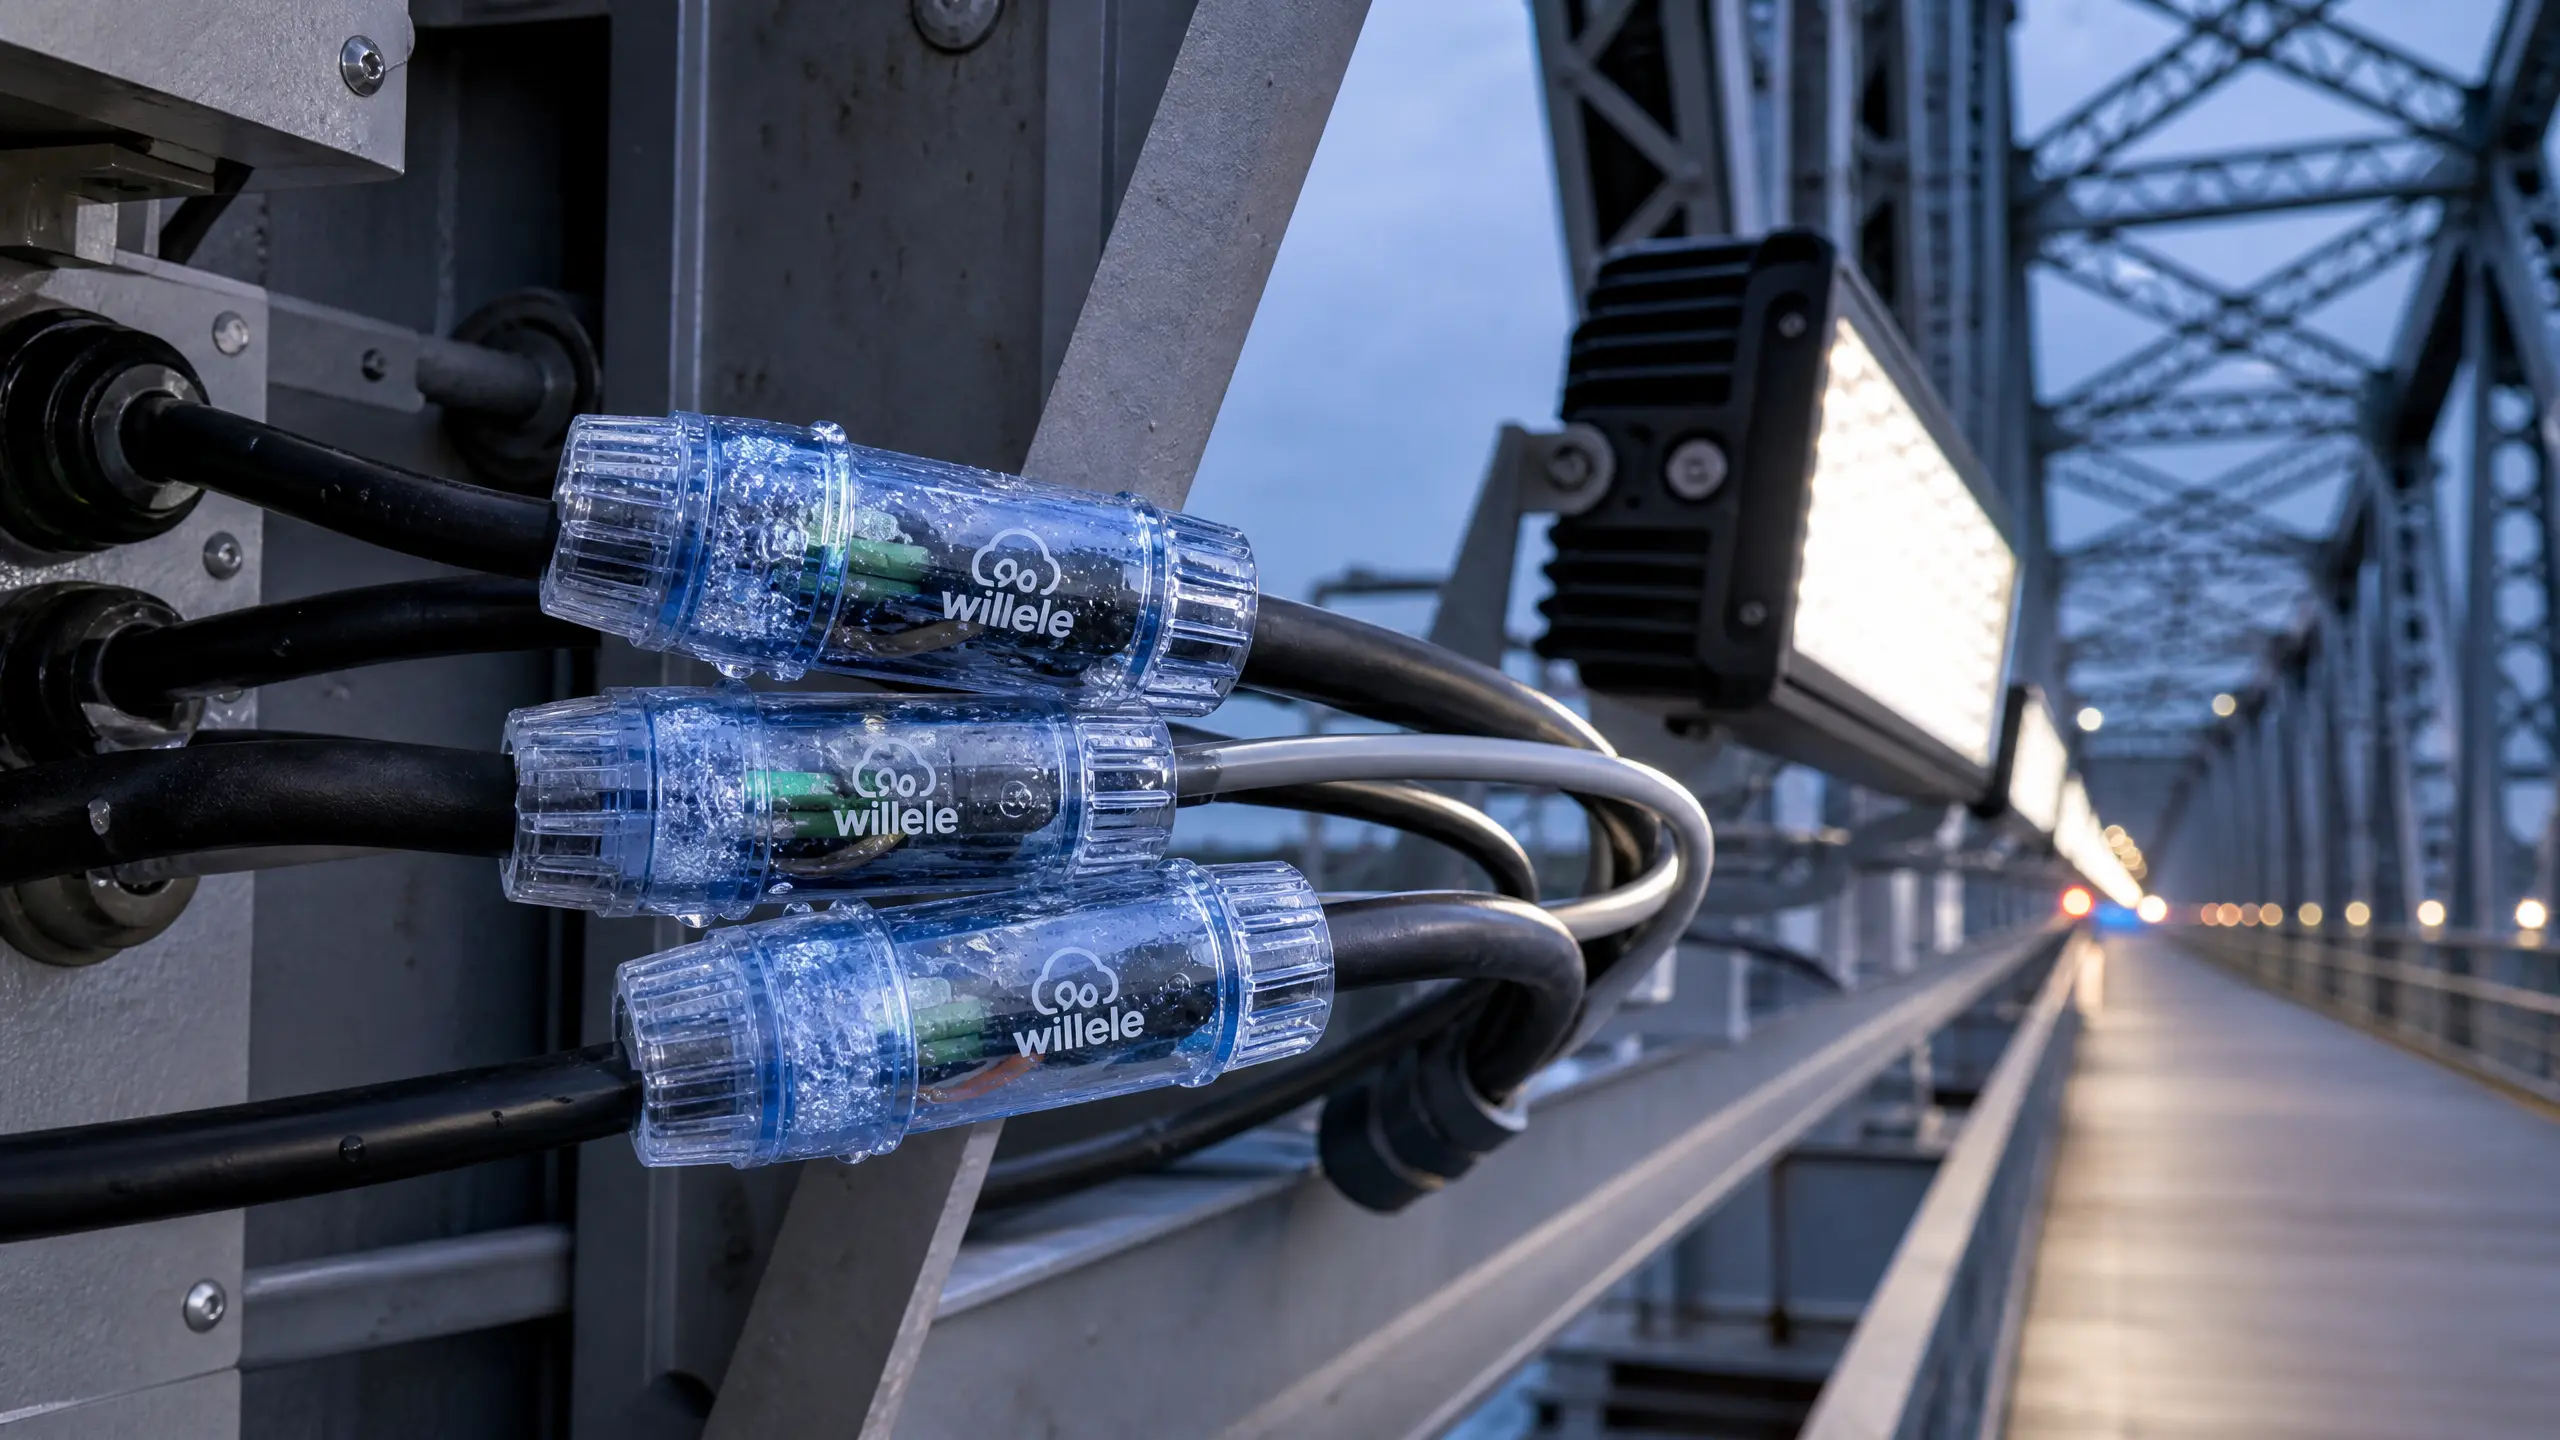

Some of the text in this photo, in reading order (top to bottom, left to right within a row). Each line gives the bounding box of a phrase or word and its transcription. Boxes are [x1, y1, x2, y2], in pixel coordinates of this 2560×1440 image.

[941, 590, 1074, 638] willele
[833, 800, 959, 837] willele
[1012, 1006, 1145, 1058] willele
